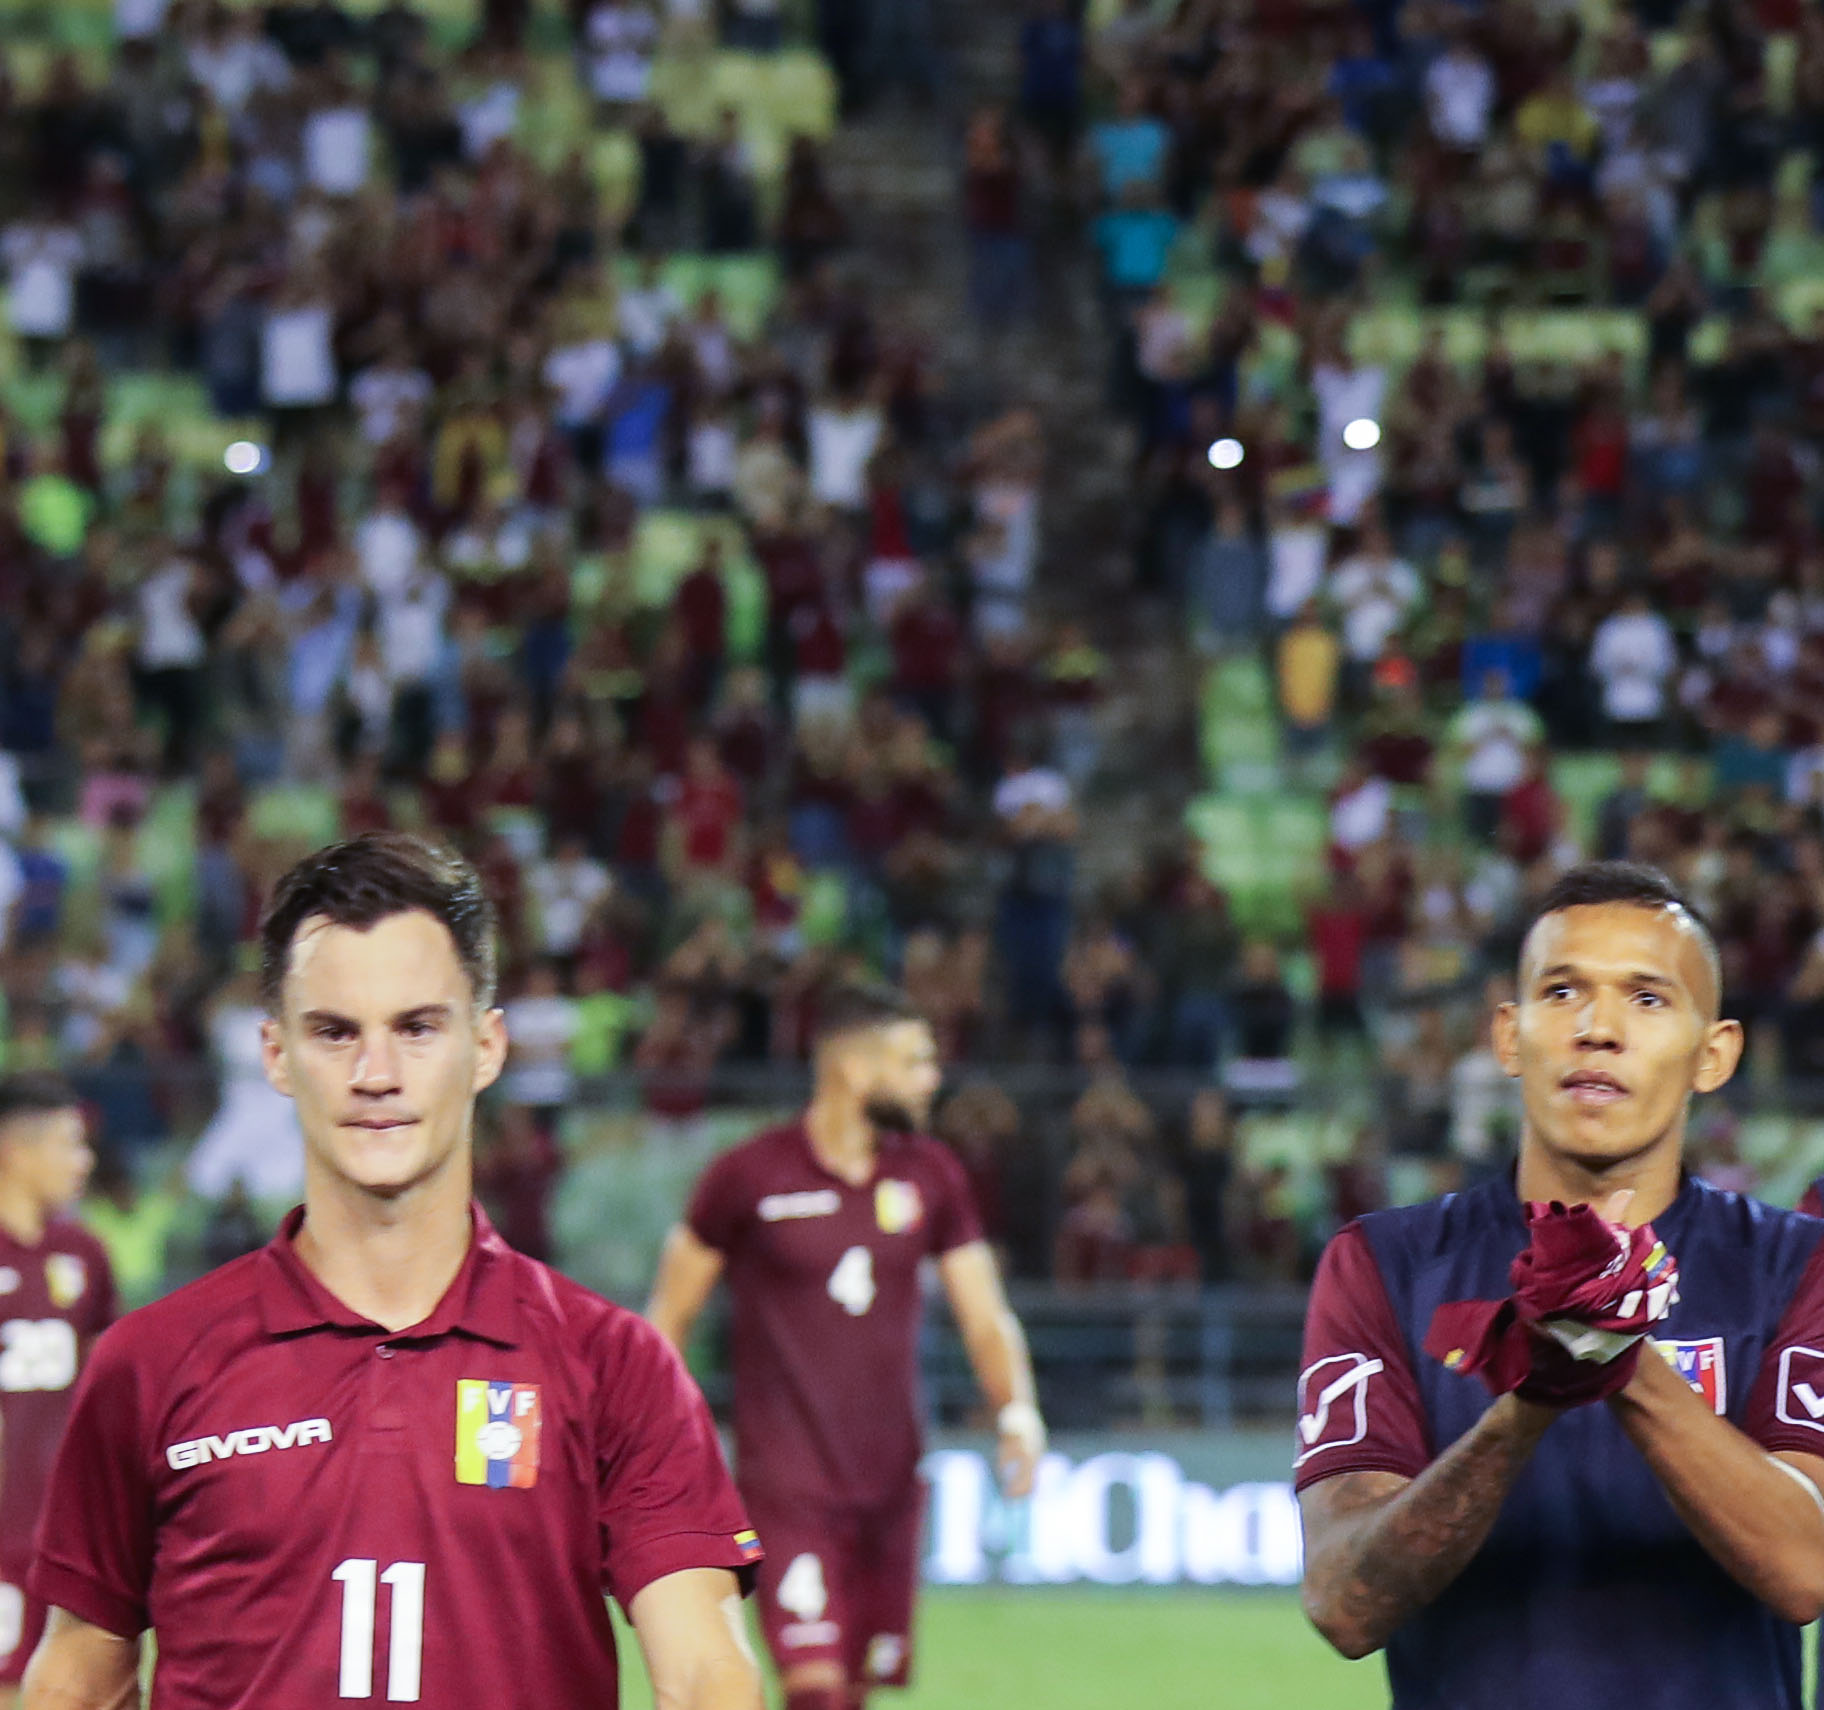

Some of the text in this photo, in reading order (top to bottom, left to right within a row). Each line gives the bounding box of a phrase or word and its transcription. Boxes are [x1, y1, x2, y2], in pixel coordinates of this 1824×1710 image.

[826, 1245, 876, 1317] 4
[460, 1387, 539, 1418] FVF
[166, 1417, 333, 1471] GIVOVA
[776, 1552, 828, 1622] 4
[331, 1558, 427, 1703] 11
